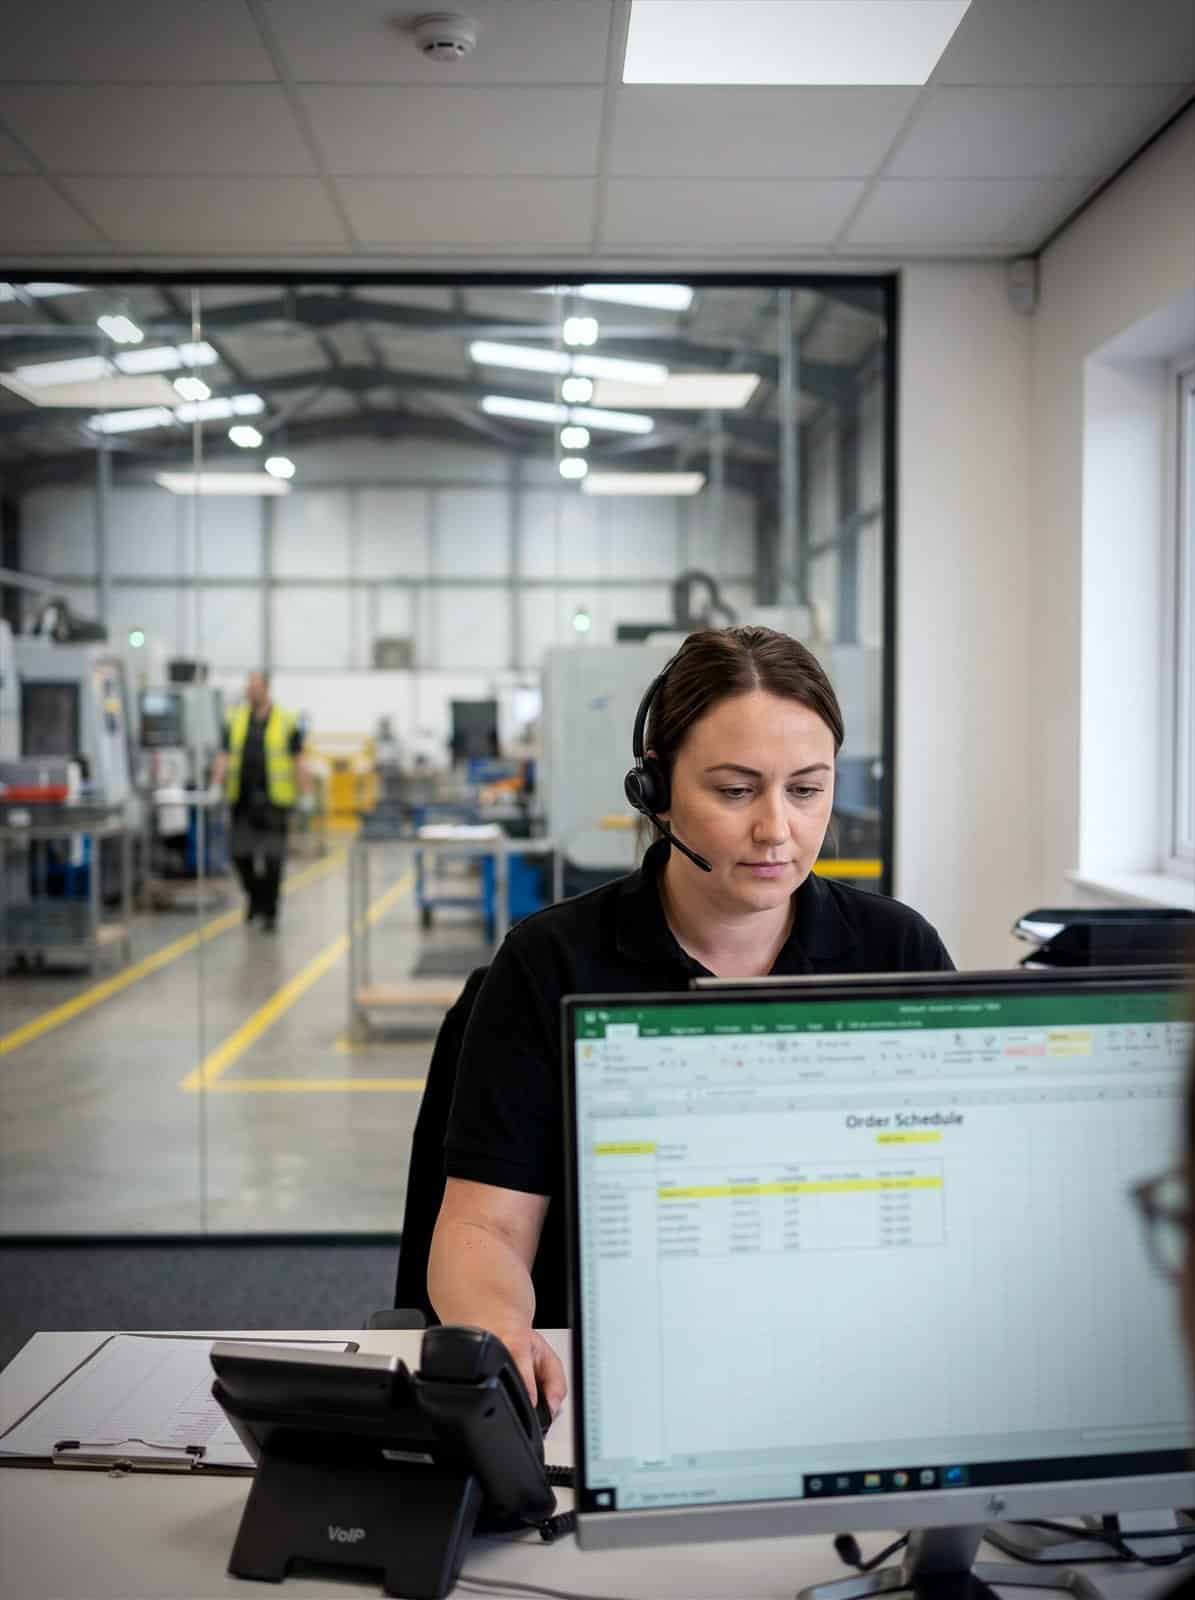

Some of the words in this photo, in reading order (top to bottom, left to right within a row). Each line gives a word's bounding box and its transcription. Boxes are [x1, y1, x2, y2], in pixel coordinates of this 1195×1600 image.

[845, 1114, 889, 1128] Order
[895, 1110, 964, 1128] Schedule
[327, 1524, 366, 1543] VoIP
